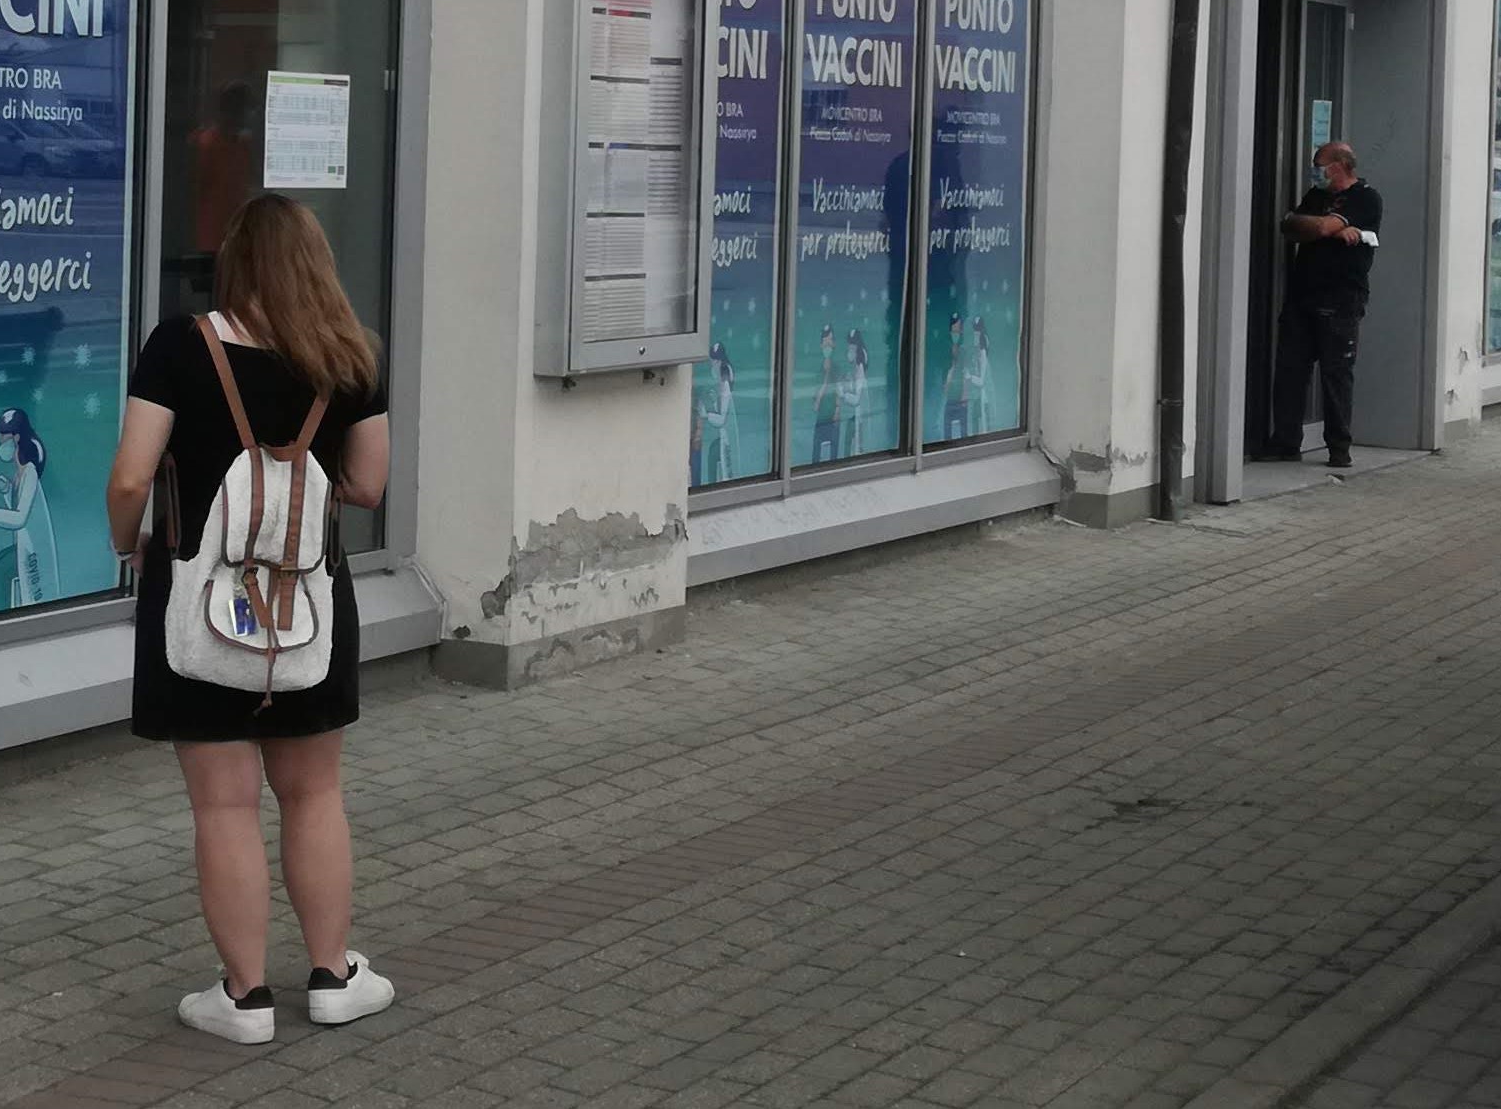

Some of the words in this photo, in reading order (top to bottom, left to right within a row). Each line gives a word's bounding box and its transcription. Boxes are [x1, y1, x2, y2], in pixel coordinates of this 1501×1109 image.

[806, 33, 903, 88] VACCINI
[935, 44, 1016, 93] VACCINI
[33, 68, 63, 90] BRA
[2, 98, 17, 120] di
[21, 100, 84, 127] Nassirya
[725, 102, 744, 117] BRA
[813, 177, 886, 213] Vacciniamoci
[940, 176, 1004, 210] Vacciniamoci
[801, 232, 823, 262] per
[825, 220, 891, 262] proteggerci
[930, 227, 950, 254] per
[953, 215, 1010, 254] proteggerci
